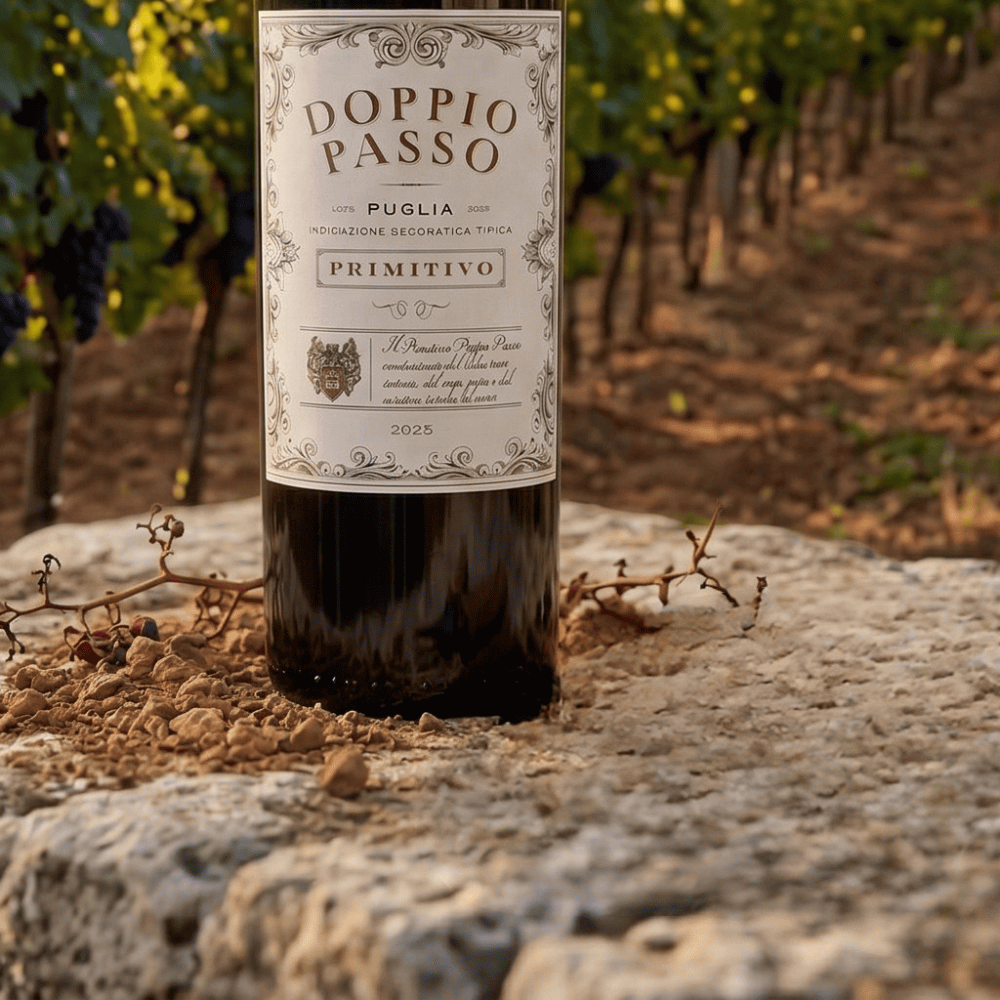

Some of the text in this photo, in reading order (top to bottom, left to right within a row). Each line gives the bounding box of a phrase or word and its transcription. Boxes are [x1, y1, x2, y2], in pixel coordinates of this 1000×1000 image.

[302, 86, 518, 136] DOPPIO
[322, 130, 500, 175] PASSO
[367, 203, 454, 216] PUGLIA
[476, 225, 513, 236] TIPICA
[329, 261, 494, 277] PRIMITIVO
[390, 424, 434, 436] 2025
